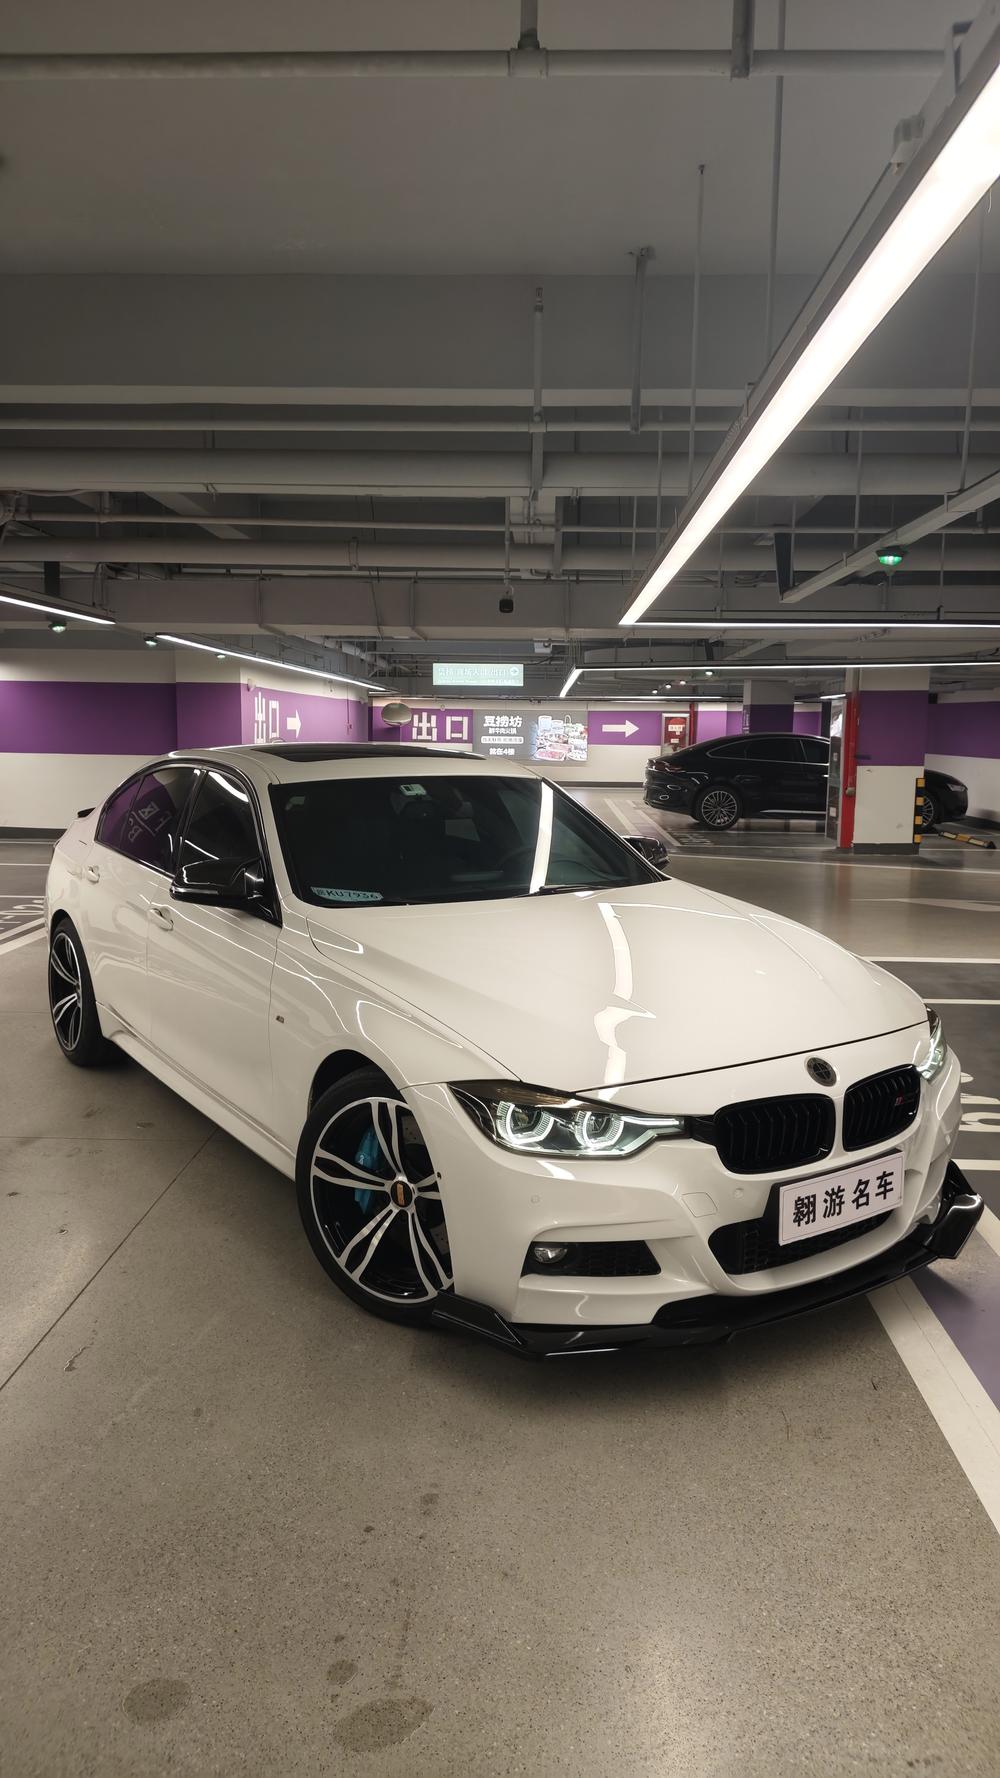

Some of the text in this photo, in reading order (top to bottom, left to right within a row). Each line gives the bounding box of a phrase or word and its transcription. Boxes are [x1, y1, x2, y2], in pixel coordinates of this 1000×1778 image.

[254, 691, 280, 744] 出口
[412, 711, 469, 741] 出口
[483, 714, 523, 728] 豆捞坊
[793, 1170, 895, 1227] 翱游名车
